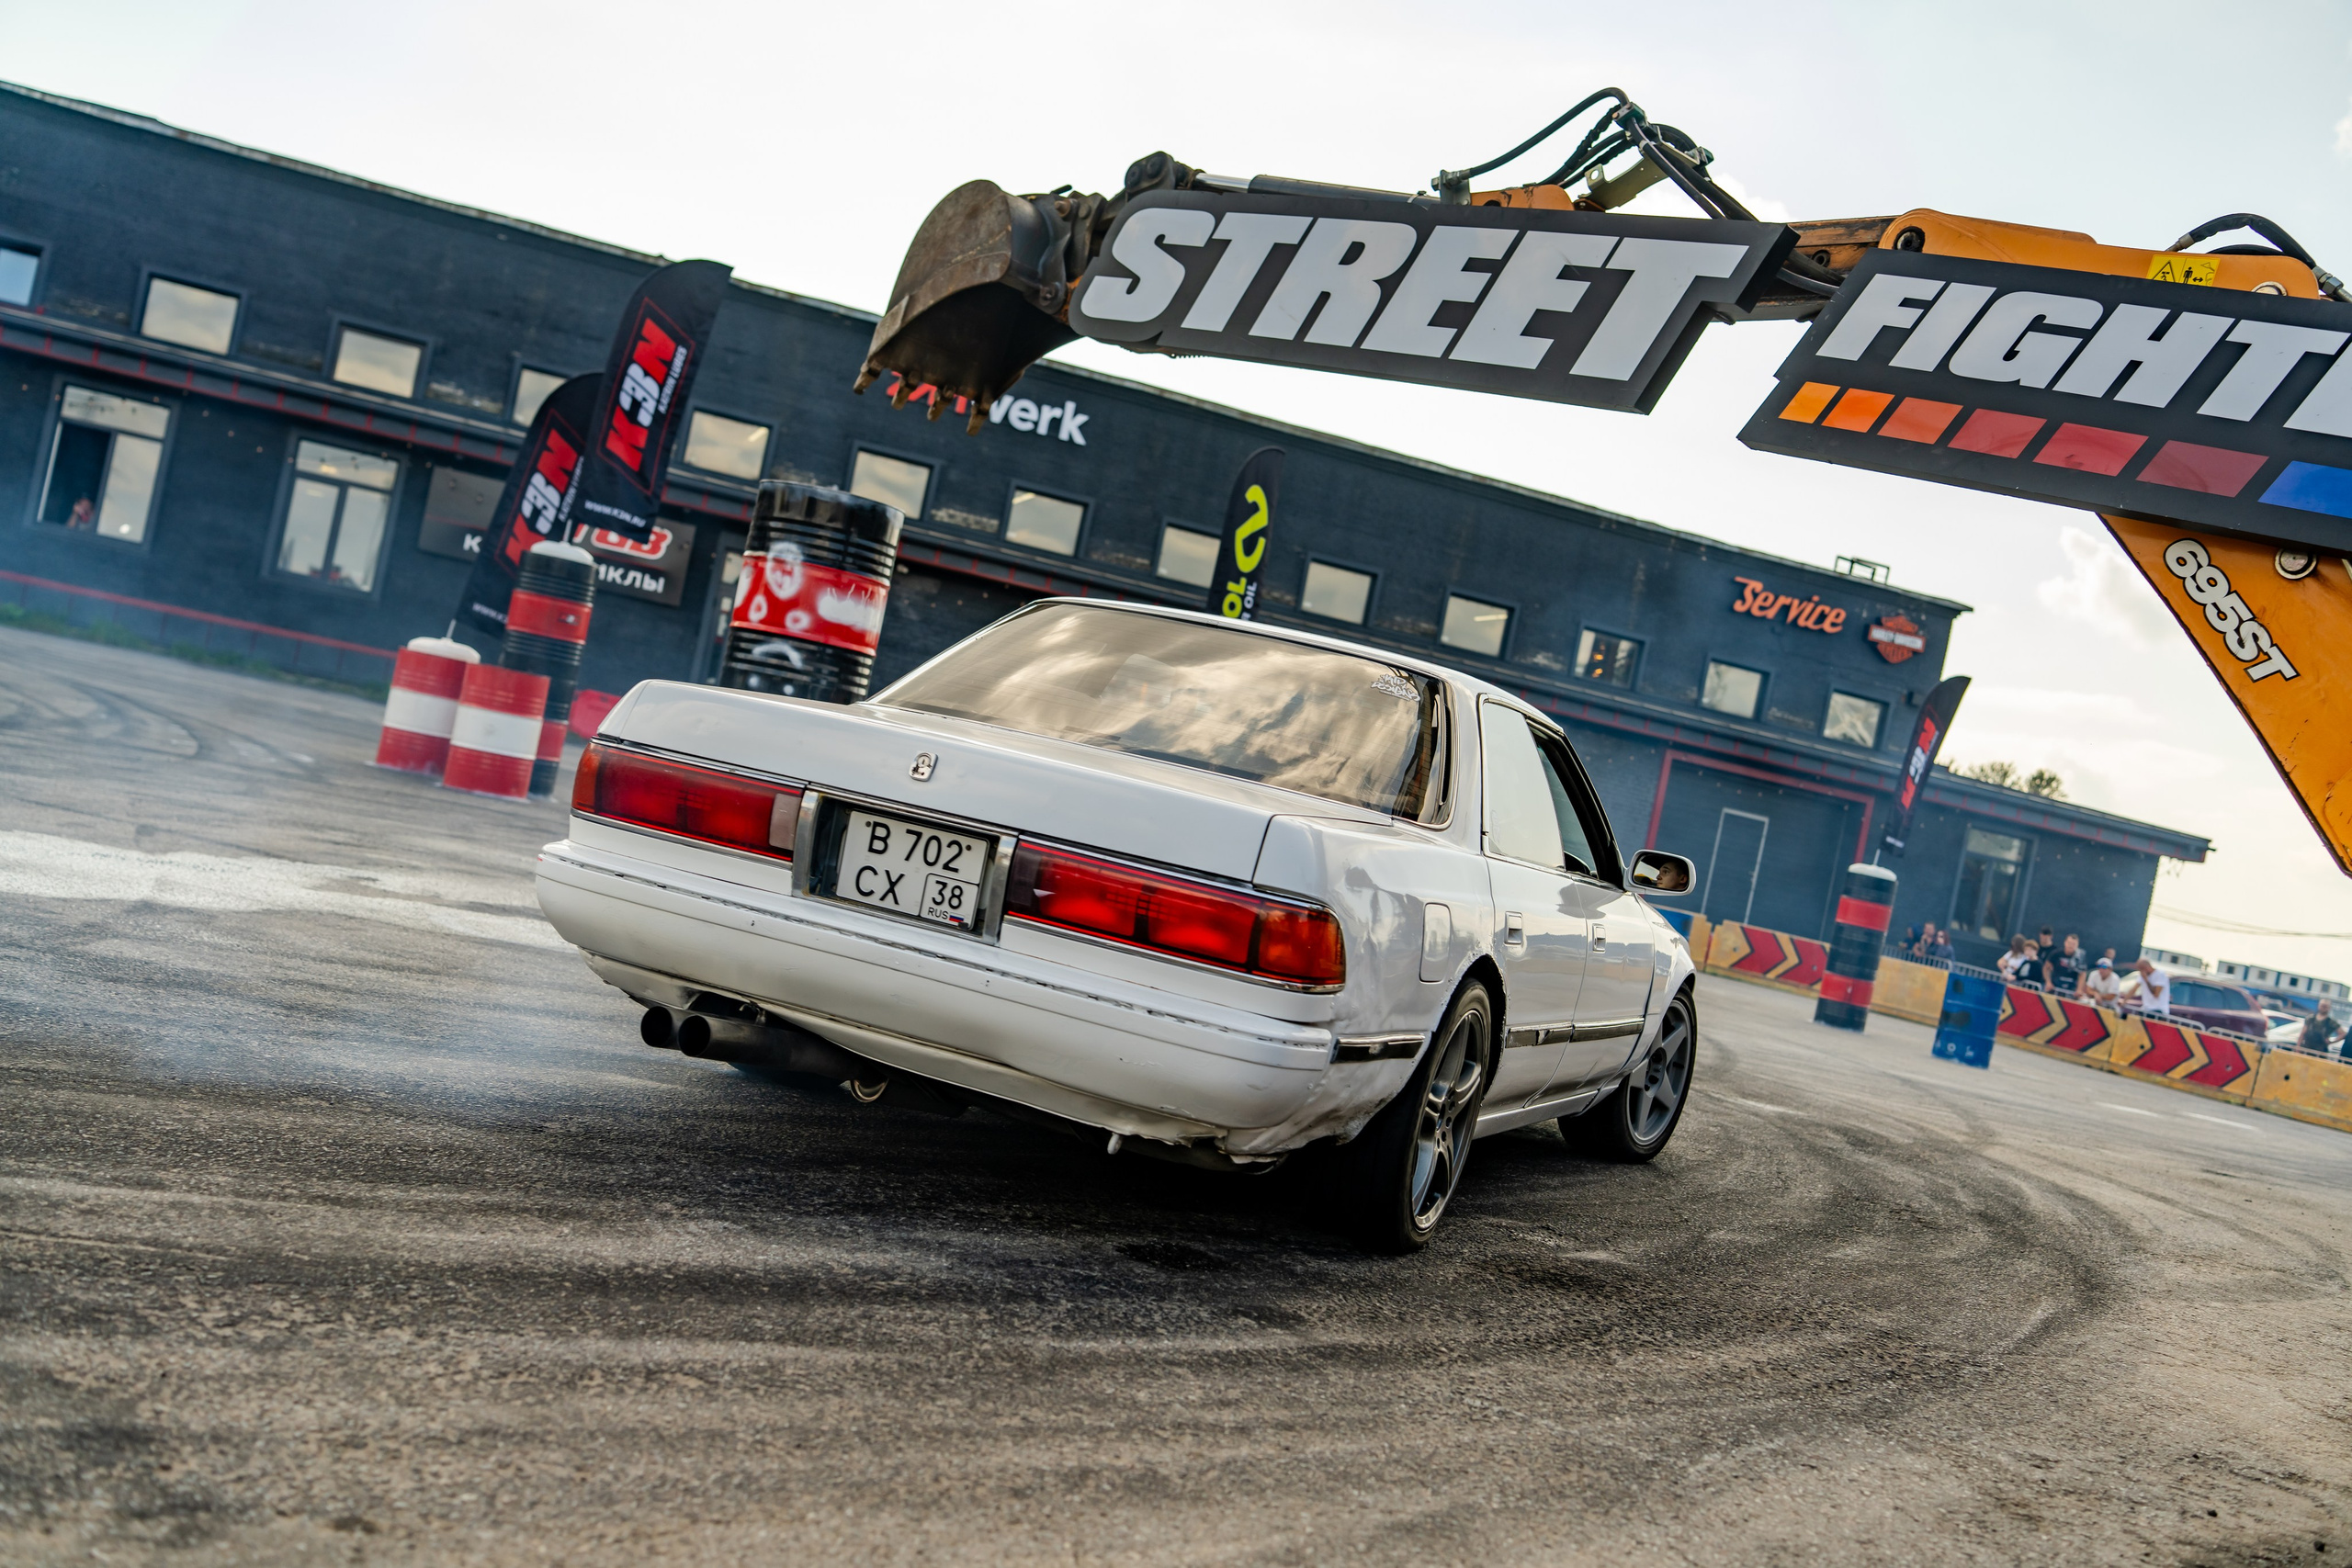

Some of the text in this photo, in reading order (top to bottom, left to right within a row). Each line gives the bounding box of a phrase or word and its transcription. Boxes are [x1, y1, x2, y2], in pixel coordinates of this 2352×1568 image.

[1080, 208, 1750, 382] STREET
[1733, 576, 1847, 634] Service
[2164, 538, 2301, 683] 695ST
[904, 829, 963, 873] 702
[927, 907, 948, 919] RUS
[932, 880, 963, 909] 38
